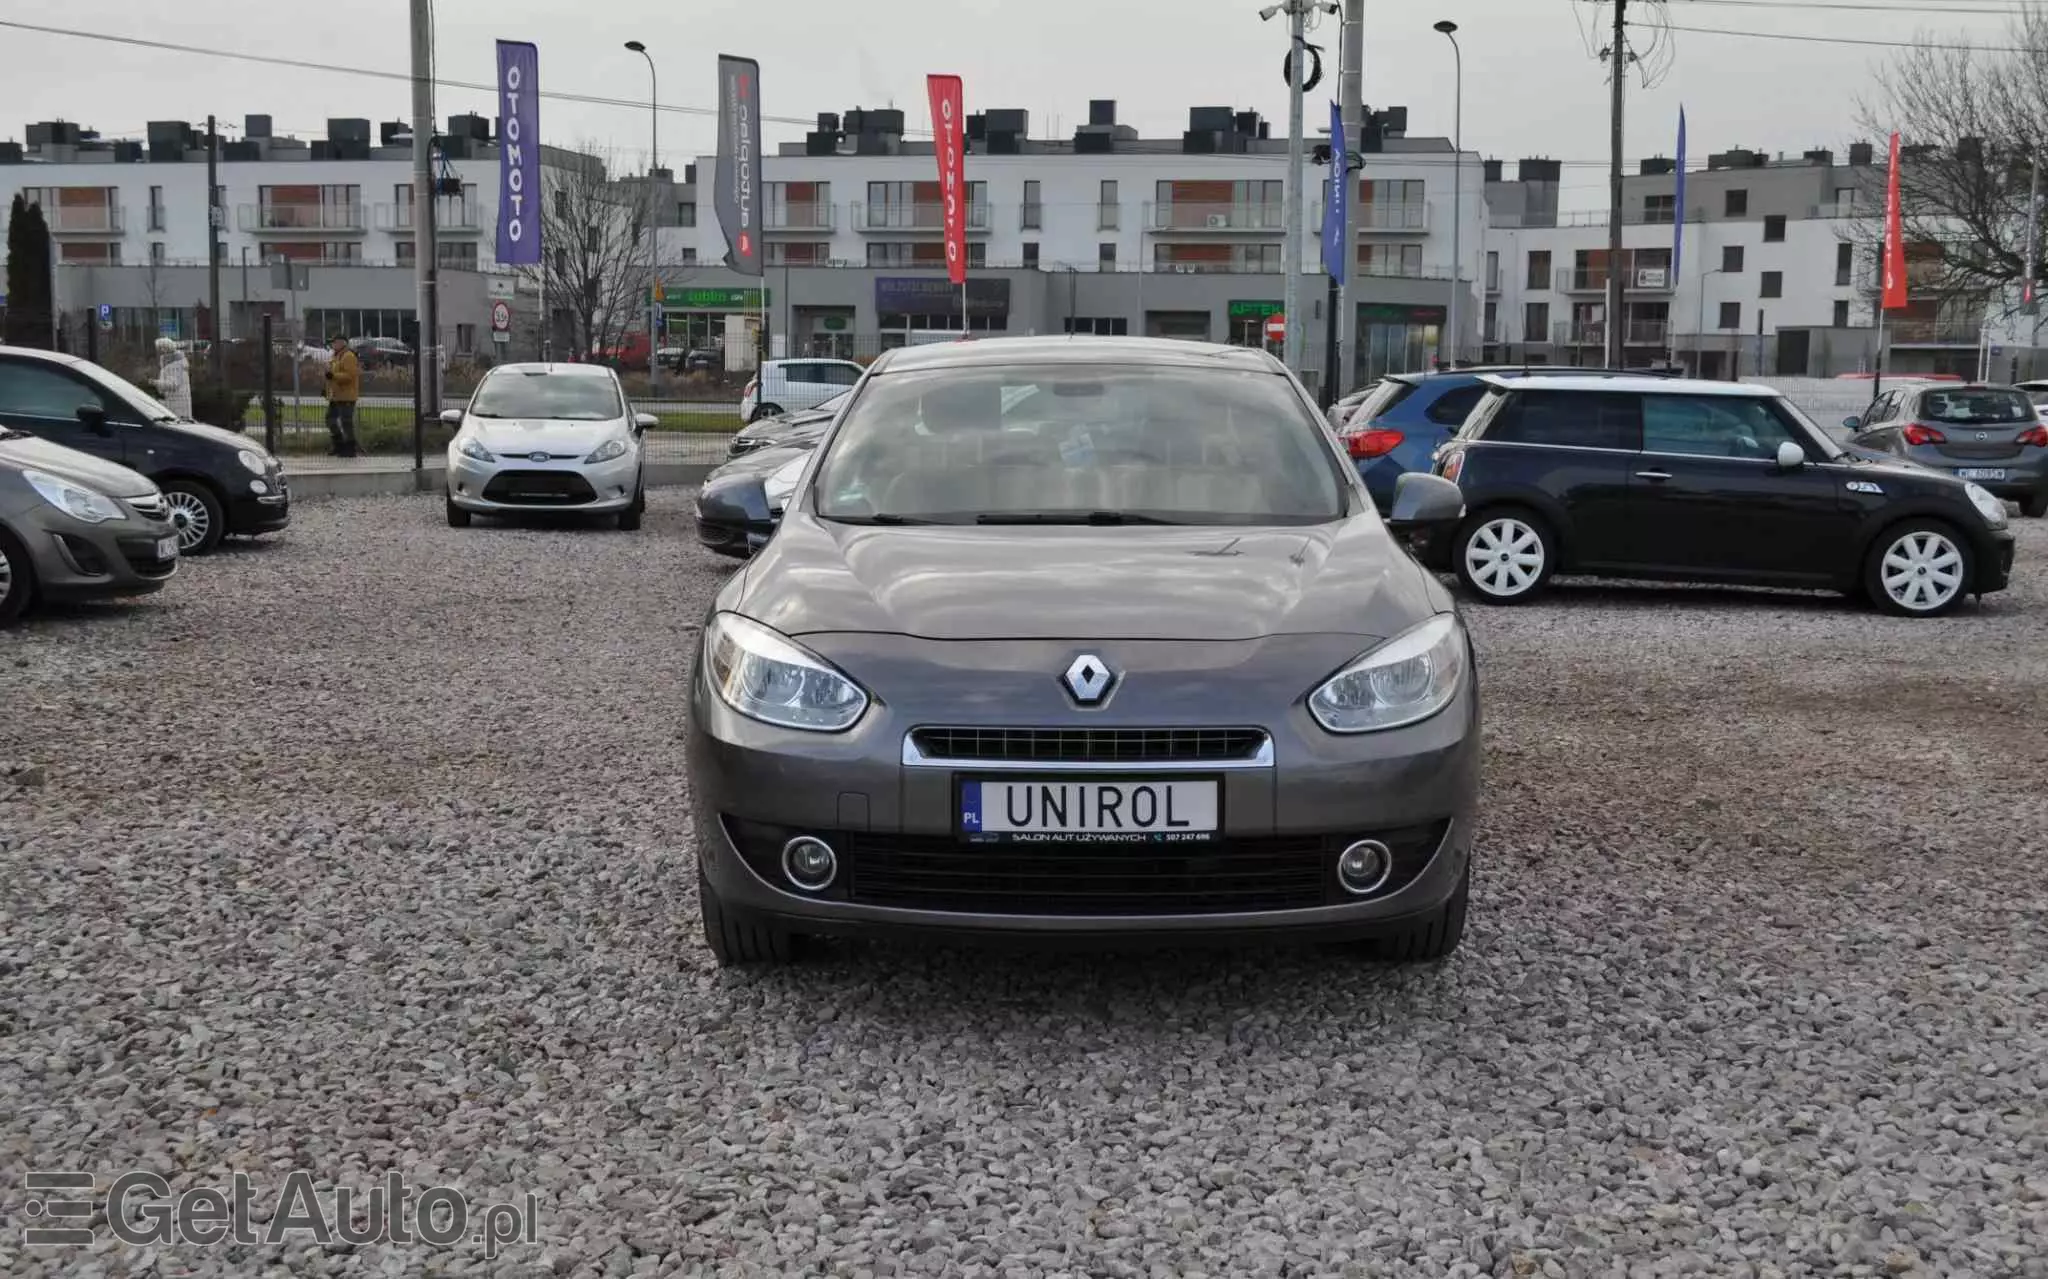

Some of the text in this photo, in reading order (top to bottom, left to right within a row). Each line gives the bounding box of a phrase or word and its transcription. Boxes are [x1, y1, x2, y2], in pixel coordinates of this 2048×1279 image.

[507, 65, 522, 242] OTOMOTO
[963, 812, 980, 824] PL
[1007, 785, 1190, 828] UNIROL
[1012, 833, 1050, 841] SALON
[1052, 833, 1075, 841] AUT
[1076, 832, 1146, 841] UŻYWANYCH
